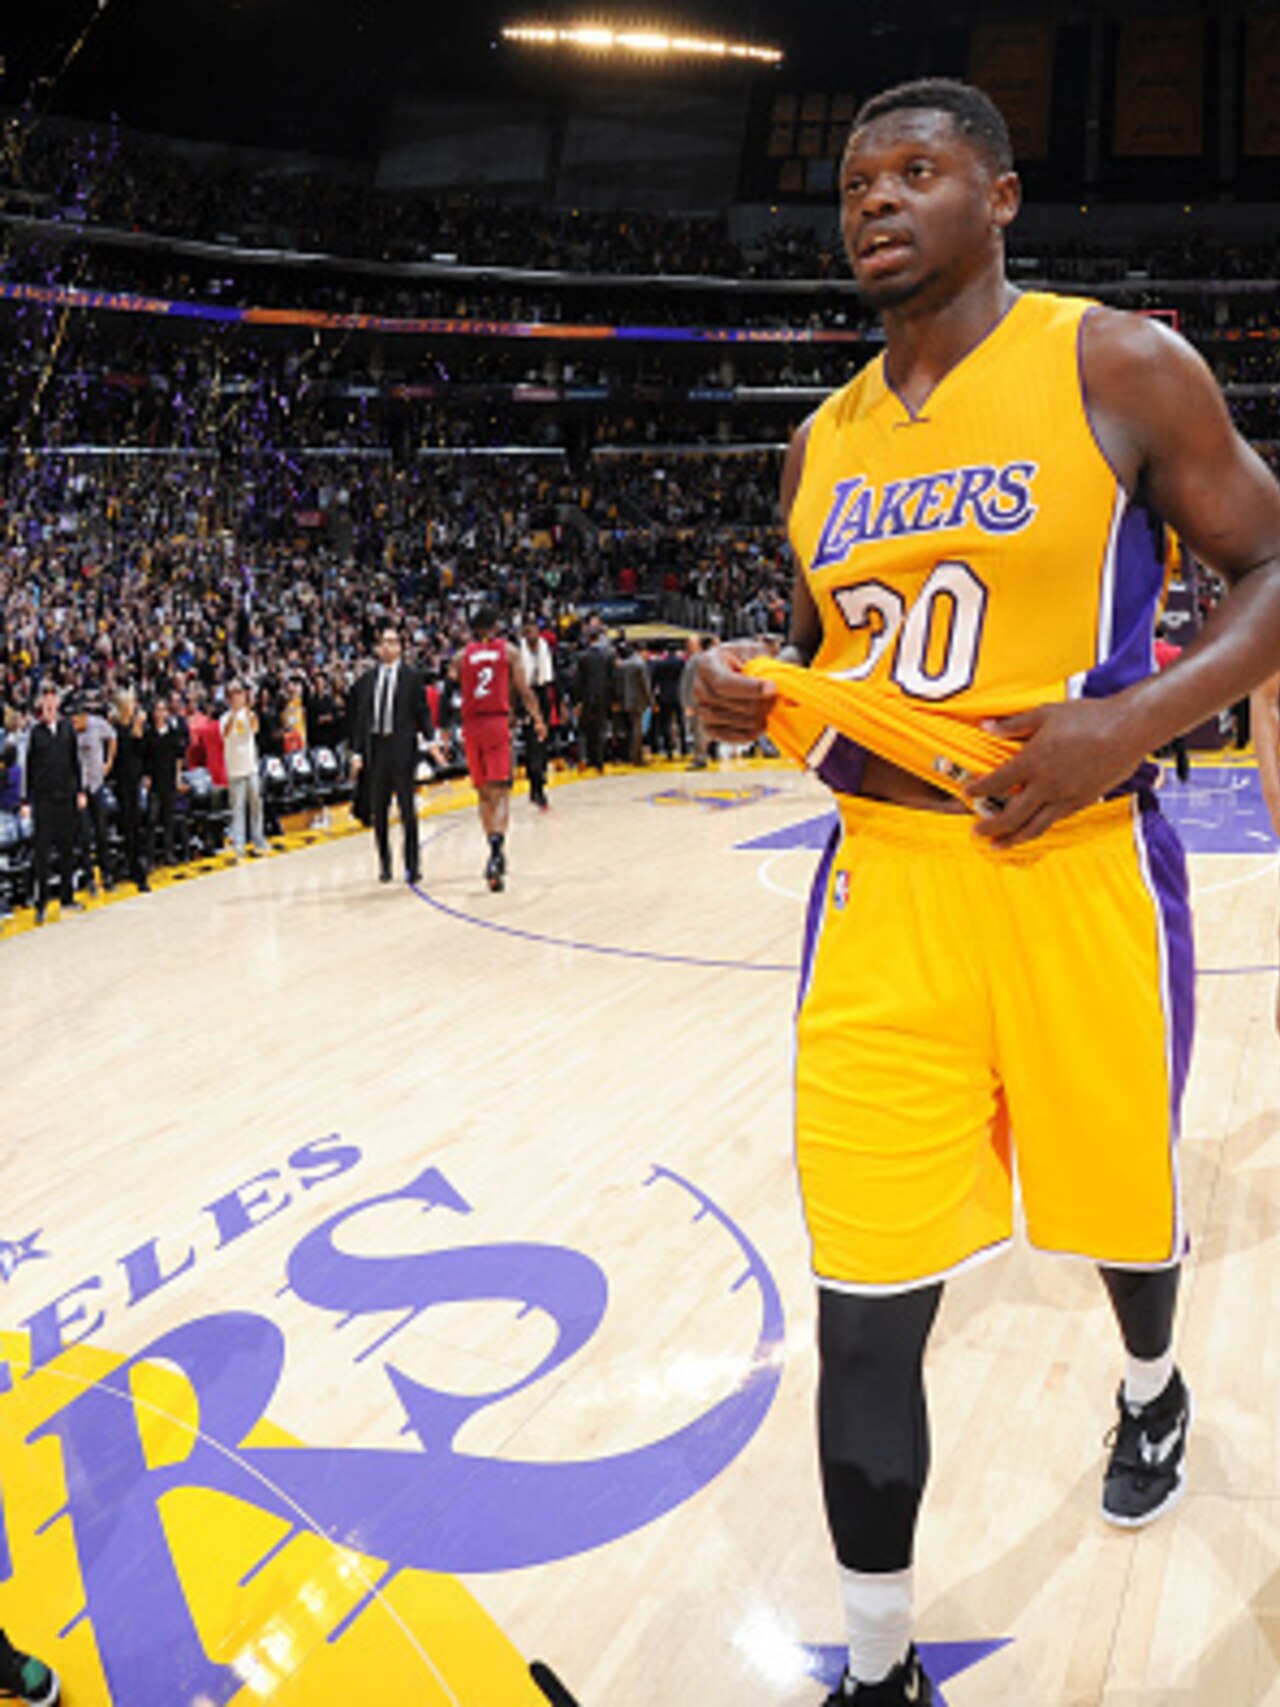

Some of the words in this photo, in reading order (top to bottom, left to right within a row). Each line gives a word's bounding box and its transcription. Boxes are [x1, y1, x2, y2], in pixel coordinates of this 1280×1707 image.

[810, 462, 1039, 572] LAKERS
[474, 666, 494, 699] 2
[0, 1133, 362, 1393] ELES
